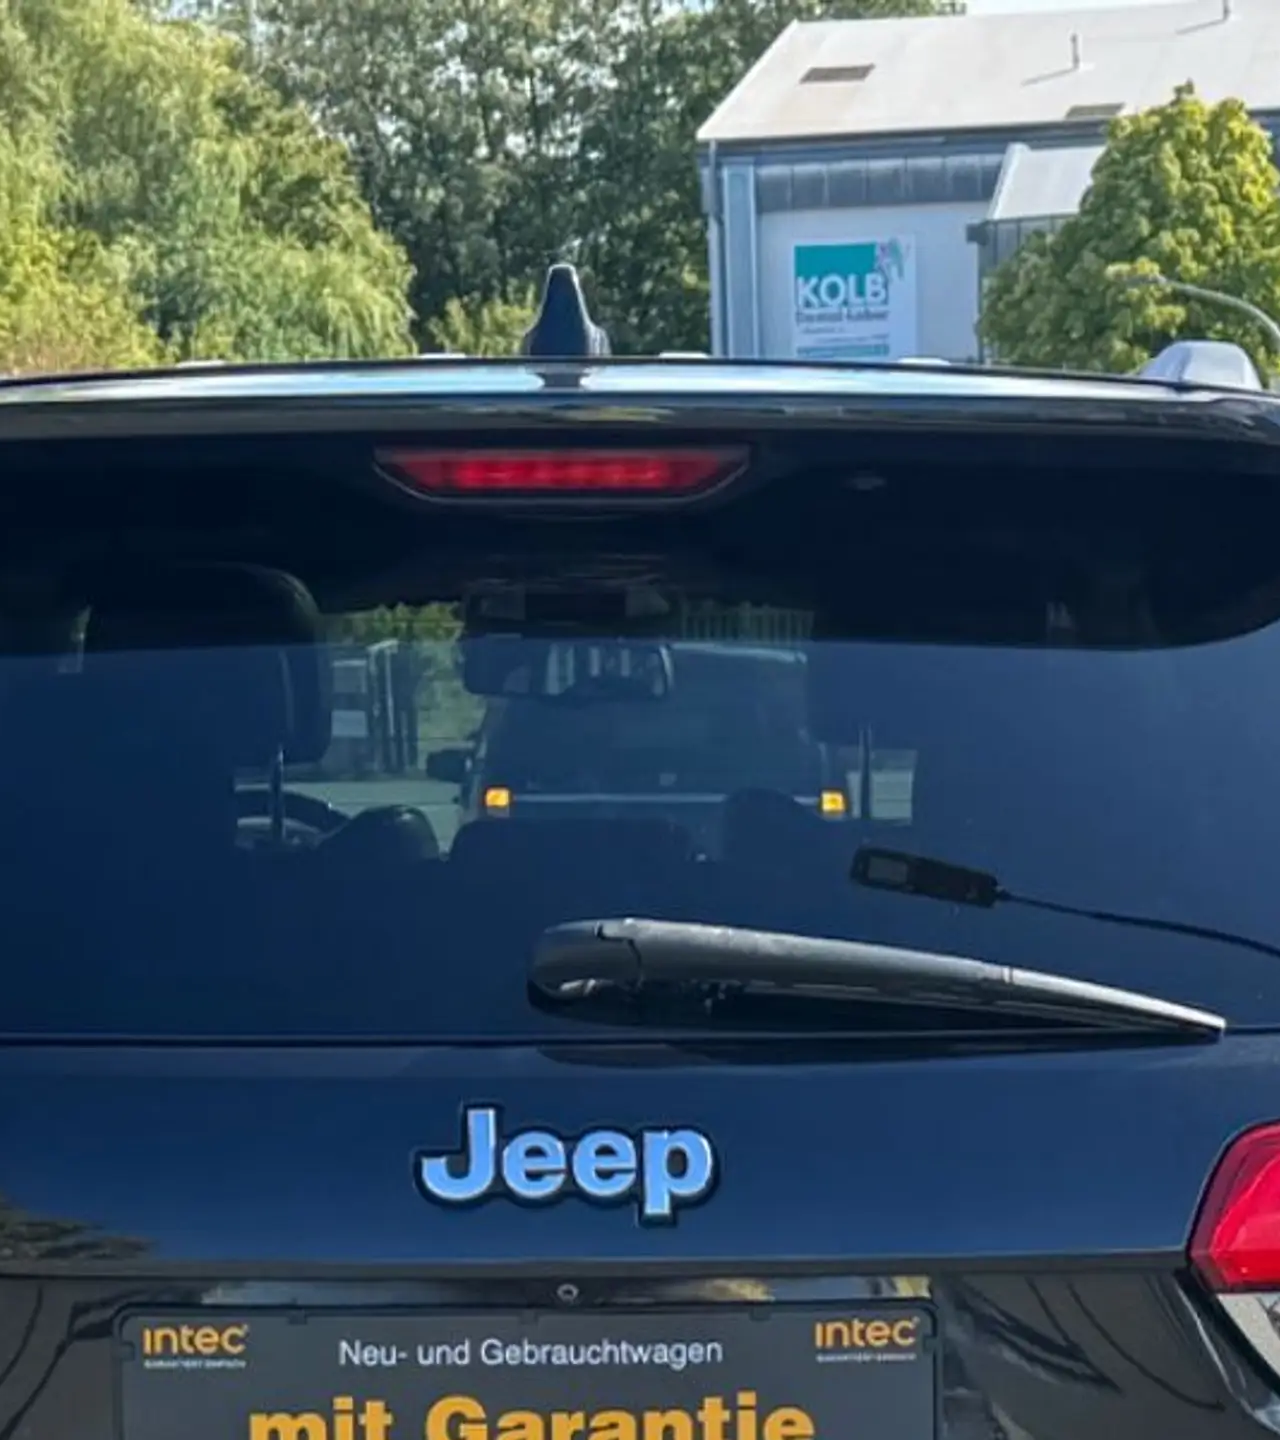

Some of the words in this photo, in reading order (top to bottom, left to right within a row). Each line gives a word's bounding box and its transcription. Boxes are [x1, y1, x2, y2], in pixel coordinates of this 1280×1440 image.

[797, 272, 886, 308] KOLB
[422, 1108, 713, 1216] Jeep
[142, 1323, 248, 1356] intec
[815, 1316, 919, 1348] intec
[339, 1339, 407, 1367] Neu-
[417, 1339, 471, 1366] und
[481, 1338, 723, 1371] Gebrauchtwagen
